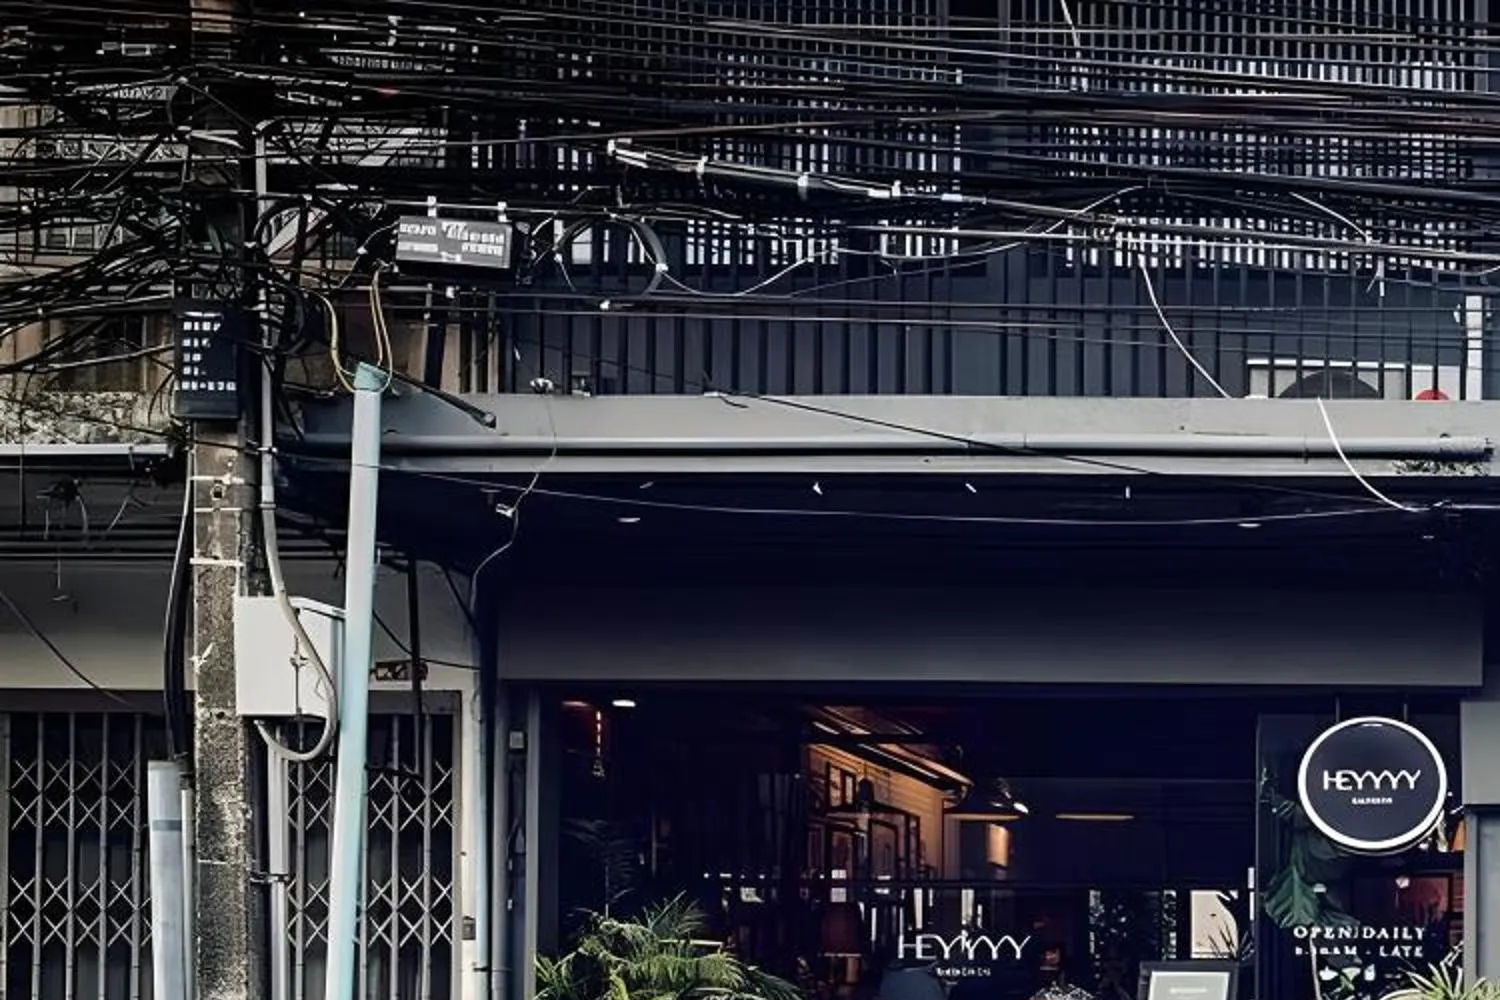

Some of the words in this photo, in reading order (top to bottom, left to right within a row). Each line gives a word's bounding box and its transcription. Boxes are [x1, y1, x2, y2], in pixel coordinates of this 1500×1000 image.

[1322, 769, 1422, 791] HEYYYY
[1293, 925, 1353, 940] OPEN
[1362, 925, 1425, 940] DAILY
[1379, 944, 1424, 957] LATE
